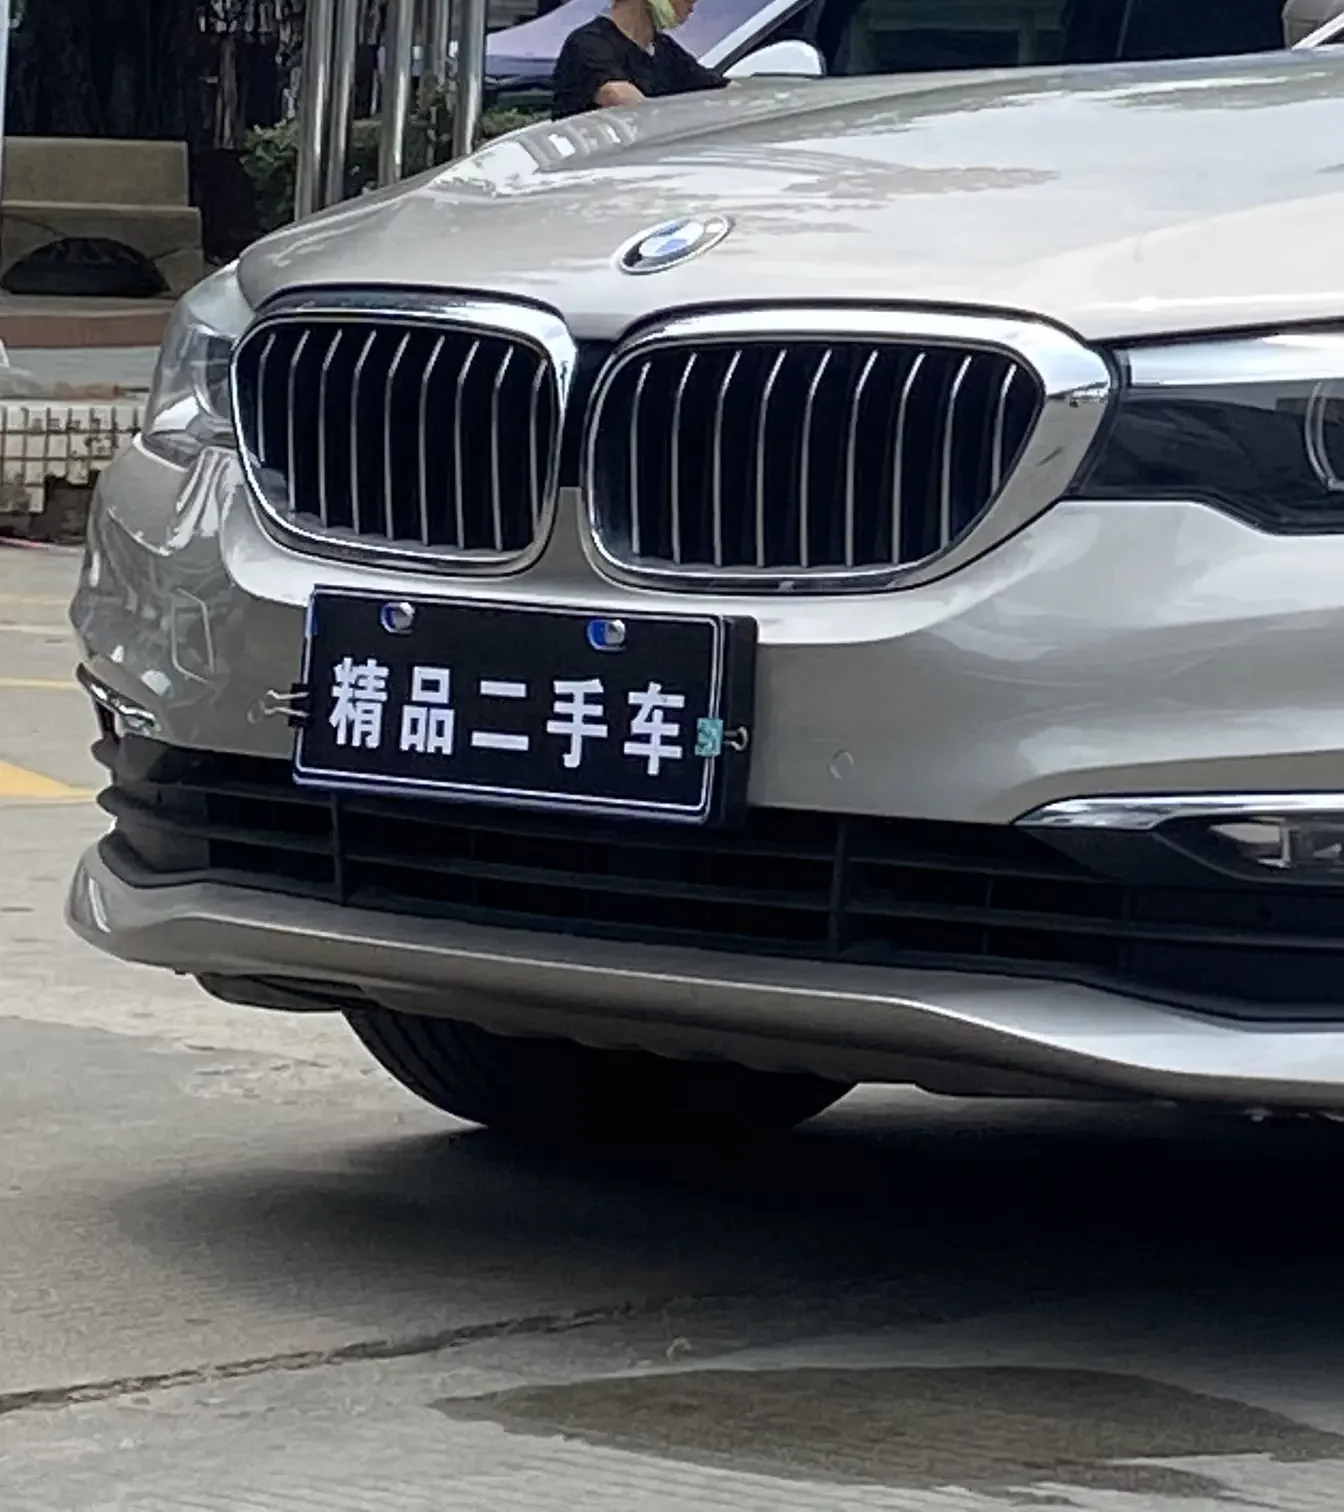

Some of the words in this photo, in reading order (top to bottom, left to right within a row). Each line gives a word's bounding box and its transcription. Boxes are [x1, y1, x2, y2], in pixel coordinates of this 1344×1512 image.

[329, 657, 685, 775] 精品二手车
